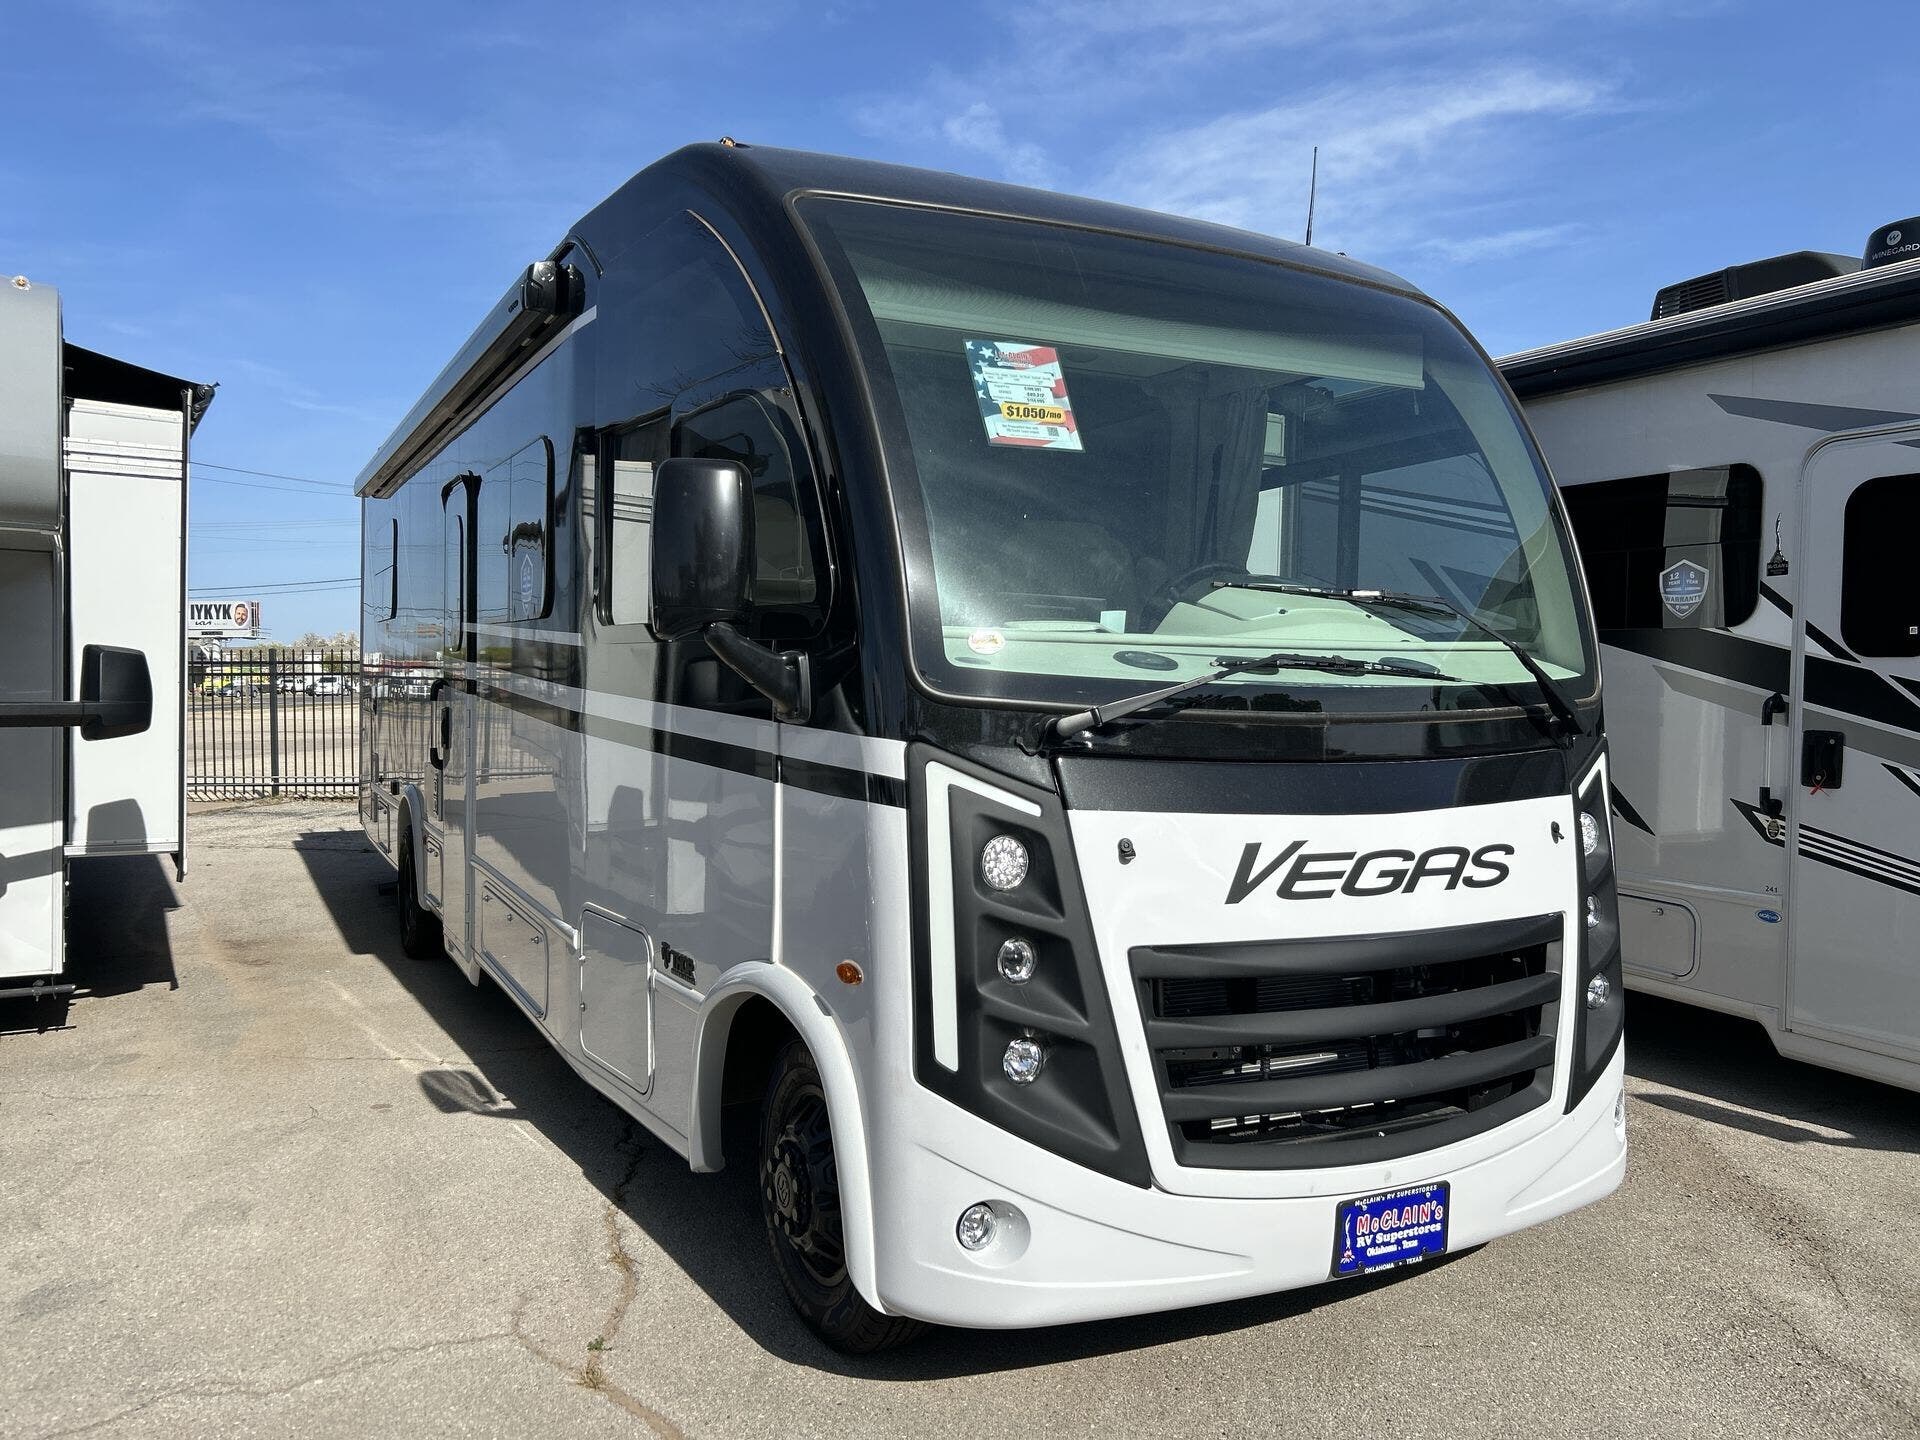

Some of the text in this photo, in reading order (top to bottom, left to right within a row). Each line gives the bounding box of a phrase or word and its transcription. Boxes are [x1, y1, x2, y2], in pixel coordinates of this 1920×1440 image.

[1872, 243, 1919, 260] WINEGARD
[1006, 405, 1062, 419] $1,050/mo
[1669, 572, 1680, 580] 12
[1689, 571, 1695, 579] 6
[190, 604, 232, 620] IYKYK
[1224, 840, 1515, 905] VEGAS
[1765, 885, 1778, 893] 241
[1386, 1192, 1396, 1200] RV
[1396, 1184, 1438, 1198] SUPERSTORES
[1356, 1222, 1441, 1248] RV Superstores
[1366, 1239, 1418, 1257] Oklahoma Texas
[1364, 1255, 1423, 1274] OKLAHOMA TEXAS
